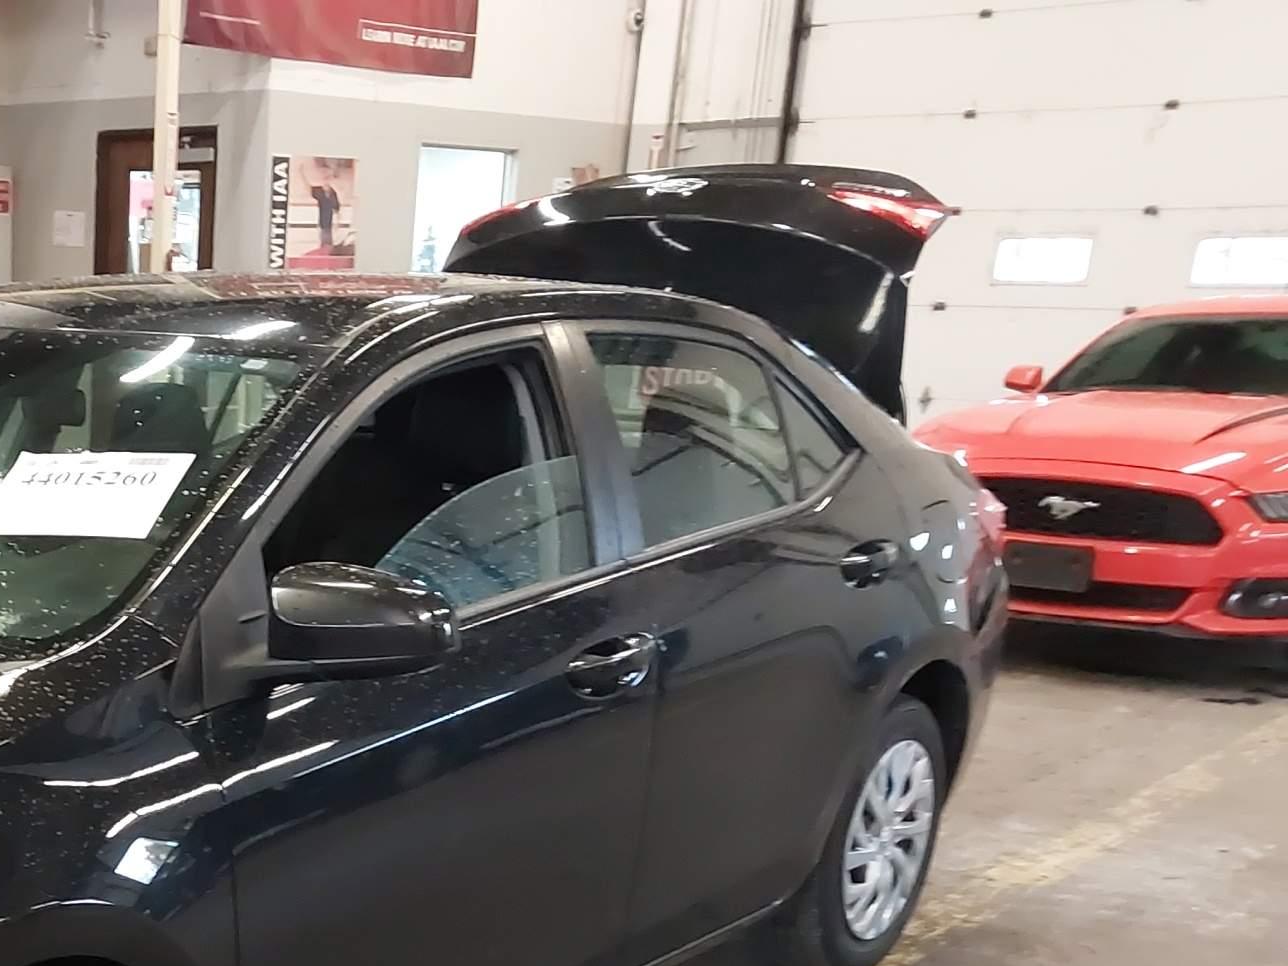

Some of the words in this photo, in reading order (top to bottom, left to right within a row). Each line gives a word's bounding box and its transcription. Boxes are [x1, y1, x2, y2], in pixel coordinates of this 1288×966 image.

[272, 162, 289, 202] IAA
[270, 208, 286, 268] WITH
[20, 471, 158, 486] 44015260
